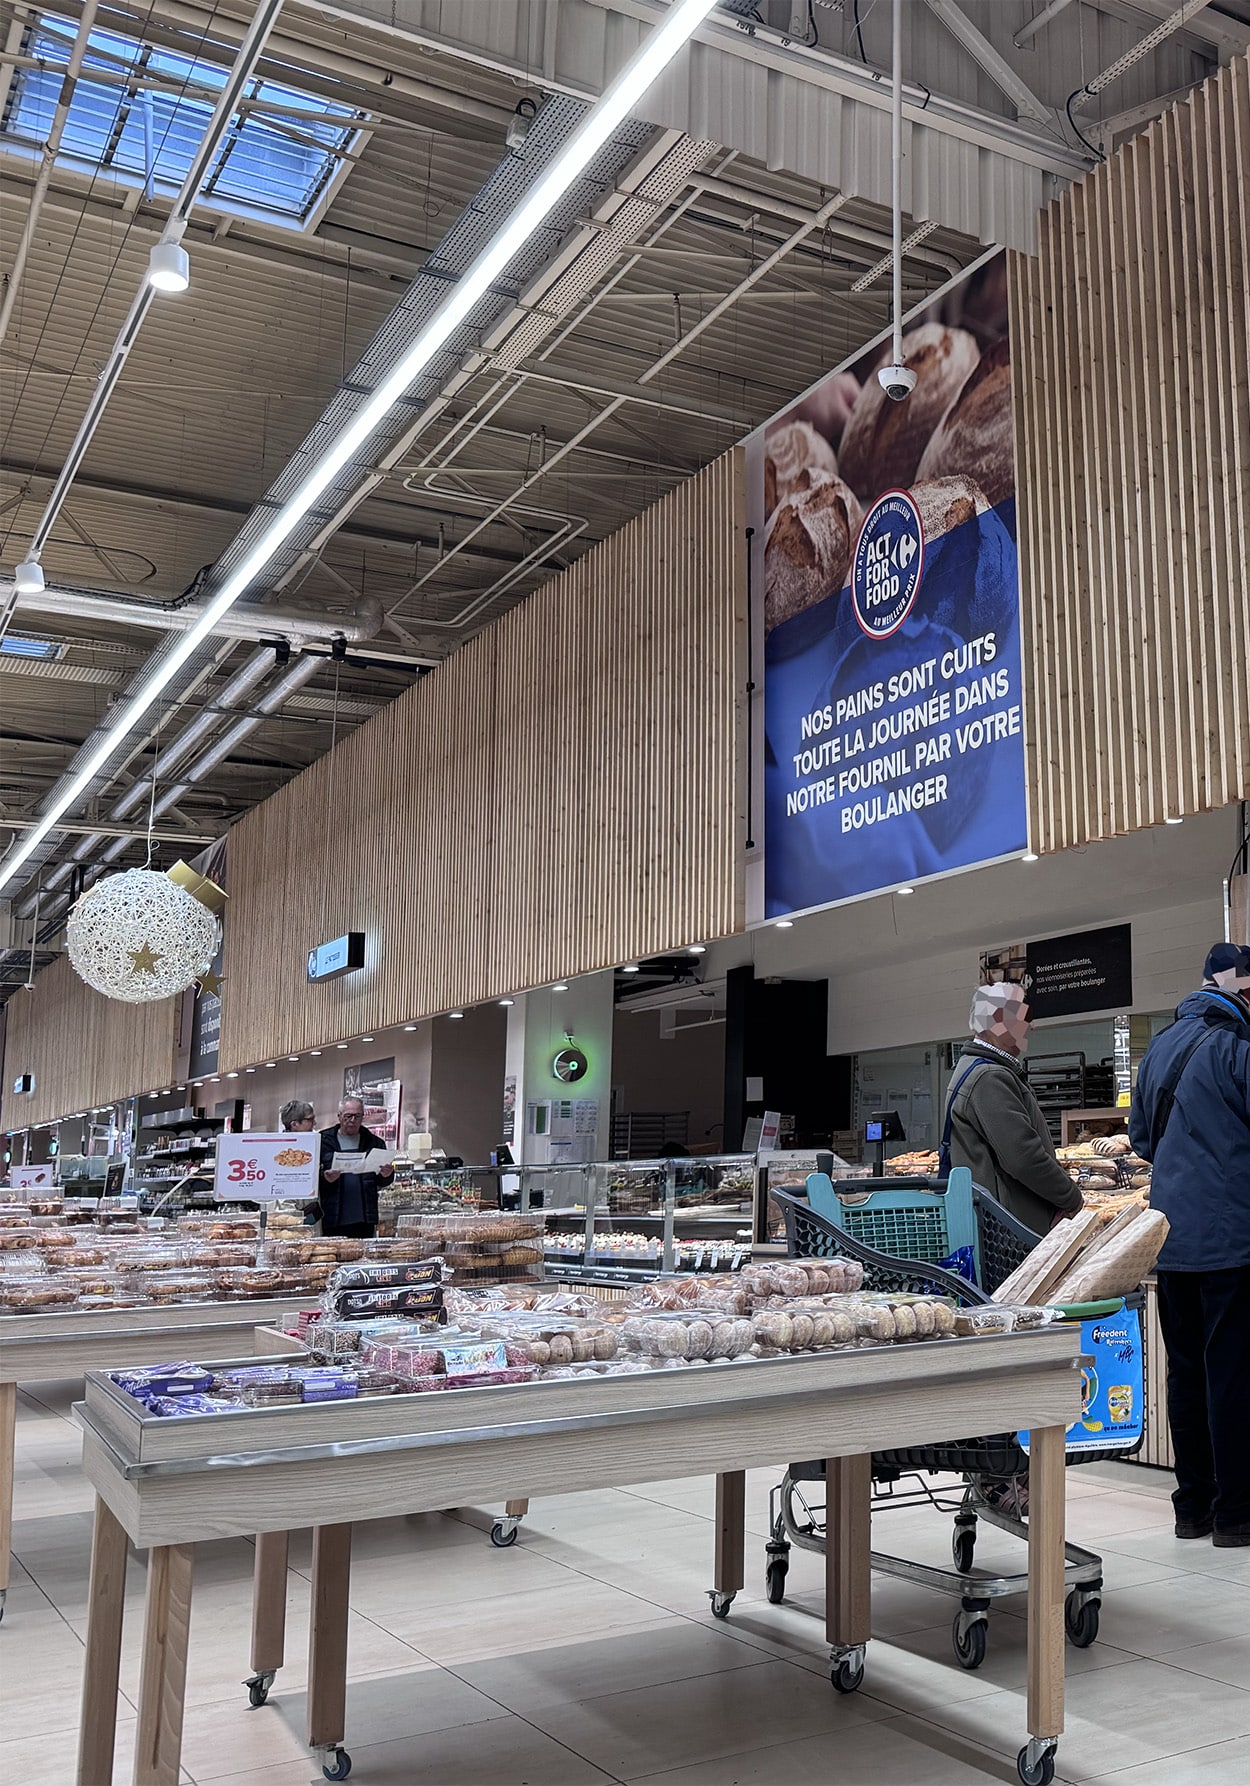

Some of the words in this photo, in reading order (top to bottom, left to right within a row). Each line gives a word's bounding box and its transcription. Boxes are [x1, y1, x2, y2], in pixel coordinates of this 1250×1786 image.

[867, 511, 881, 533] DROIT
[889, 501, 911, 521] MEILLEUR
[866, 532, 892, 567] ACT
[866, 558, 890, 588] FOR
[866, 575, 899, 610] FOOD
[881, 598, 906, 626] MEILLEUR
[905, 573, 916, 597] PRIX
[801, 705, 833, 740] NOS
[836, 682, 884, 726] PAINS
[887, 658, 937, 703] SONT
[941, 632, 996, 679] CUITS
[793, 737, 840, 778] TOUTE
[844, 729, 865, 758] LA
[869, 690, 950, 749] JOURNÉE
[955, 669, 1009, 715] DANS
[786, 776, 835, 817] NOTRE
[839, 749, 911, 797] FOURNIL
[915, 733, 951, 769] PAR
[955, 705, 1020, 754] VOTRE
[841, 774, 948, 833] BOULANGER
[1093, 1329, 1127, 1340] Freedent
